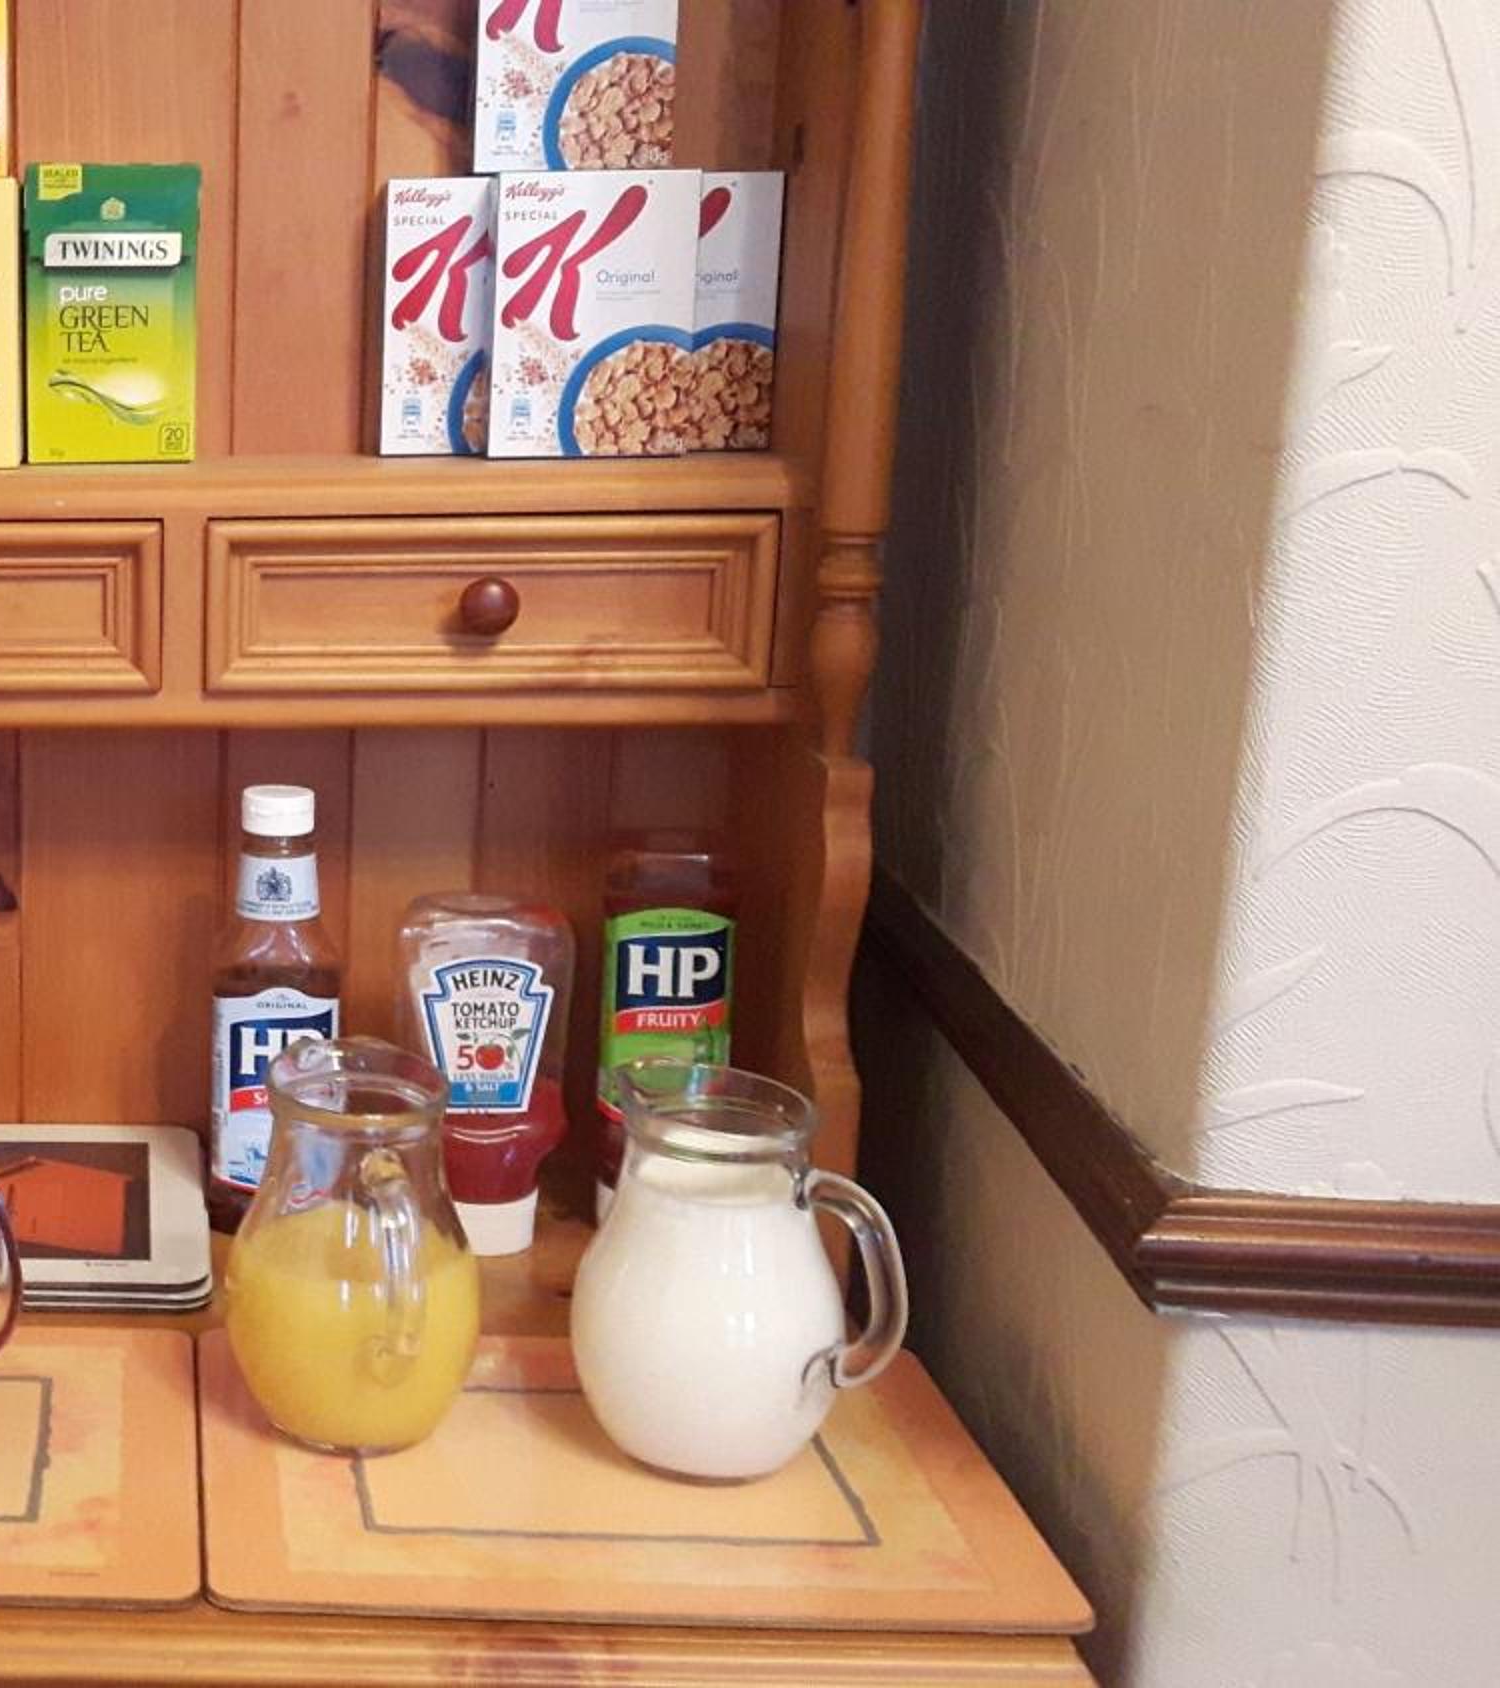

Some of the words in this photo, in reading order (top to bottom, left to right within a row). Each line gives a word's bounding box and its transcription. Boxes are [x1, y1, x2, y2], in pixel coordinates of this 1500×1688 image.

[393, 186, 451, 207] Kellogg's
[505, 180, 565, 202] Kellogg's
[393, 215, 446, 226] SPECIAL
[504, 210, 559, 221] SPECIAL
[58, 240, 169, 260] TWININGS
[501, 184, 648, 341] K
[596, 270, 655, 287] Original
[58, 286, 108, 305] pure
[59, 304, 149, 330] GREEN
[59, 330, 112, 353] TEA
[164, 427, 185, 441] 20
[451, 969, 520, 991] HEINZ
[627, 943, 721, 998] HP
[255, 1001, 309, 1010] ORIGINAL
[451, 1001, 520, 1017] TOMATO
[455, 1018, 517, 1029] KETCHUP
[636, 1011, 702, 1028] FRUITY
